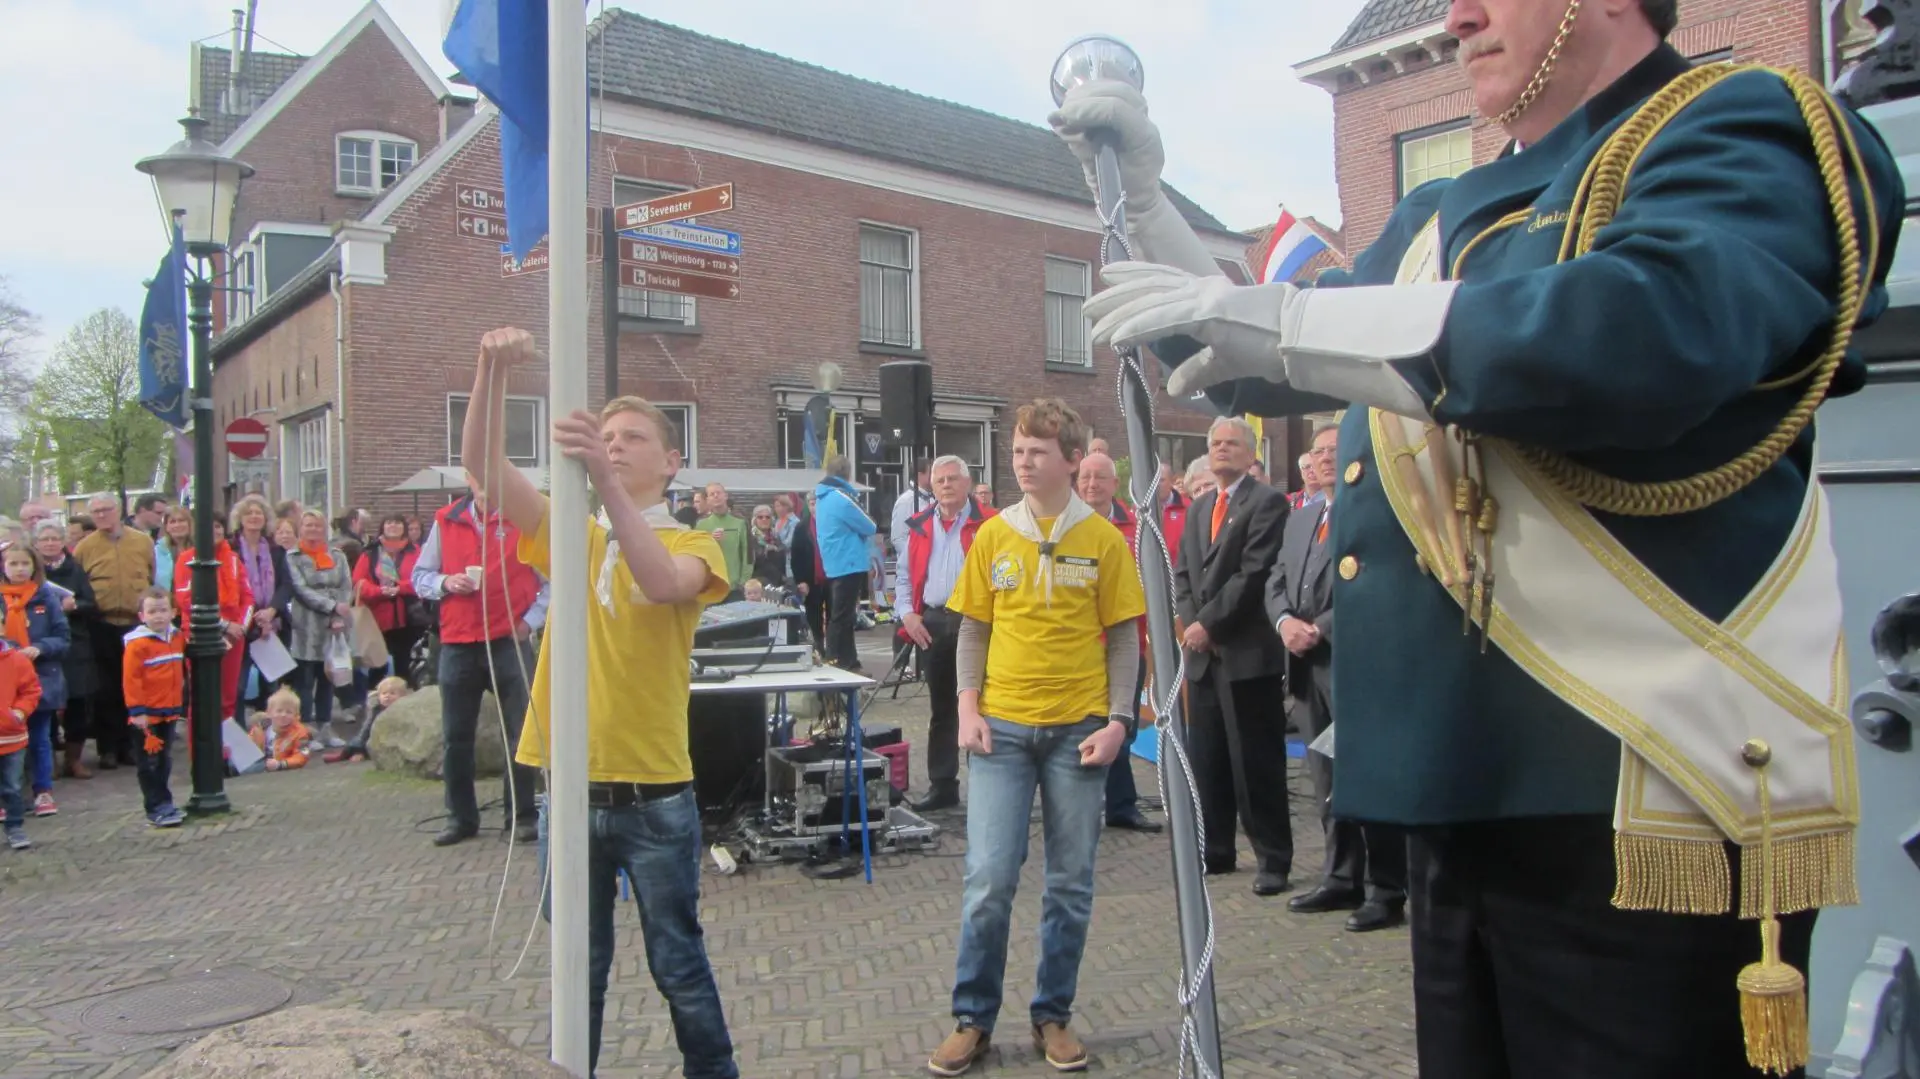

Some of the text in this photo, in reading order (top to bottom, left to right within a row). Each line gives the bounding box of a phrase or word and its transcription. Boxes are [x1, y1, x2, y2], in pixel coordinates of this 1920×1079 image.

[650, 201, 693, 218] Sevenster
[673, 228, 725, 247] Treinstation
[659, 249, 705, 269] Weijenborg
[646, 273, 681, 288] Twickel
[1054, 564, 1098, 580] SCOUTING
